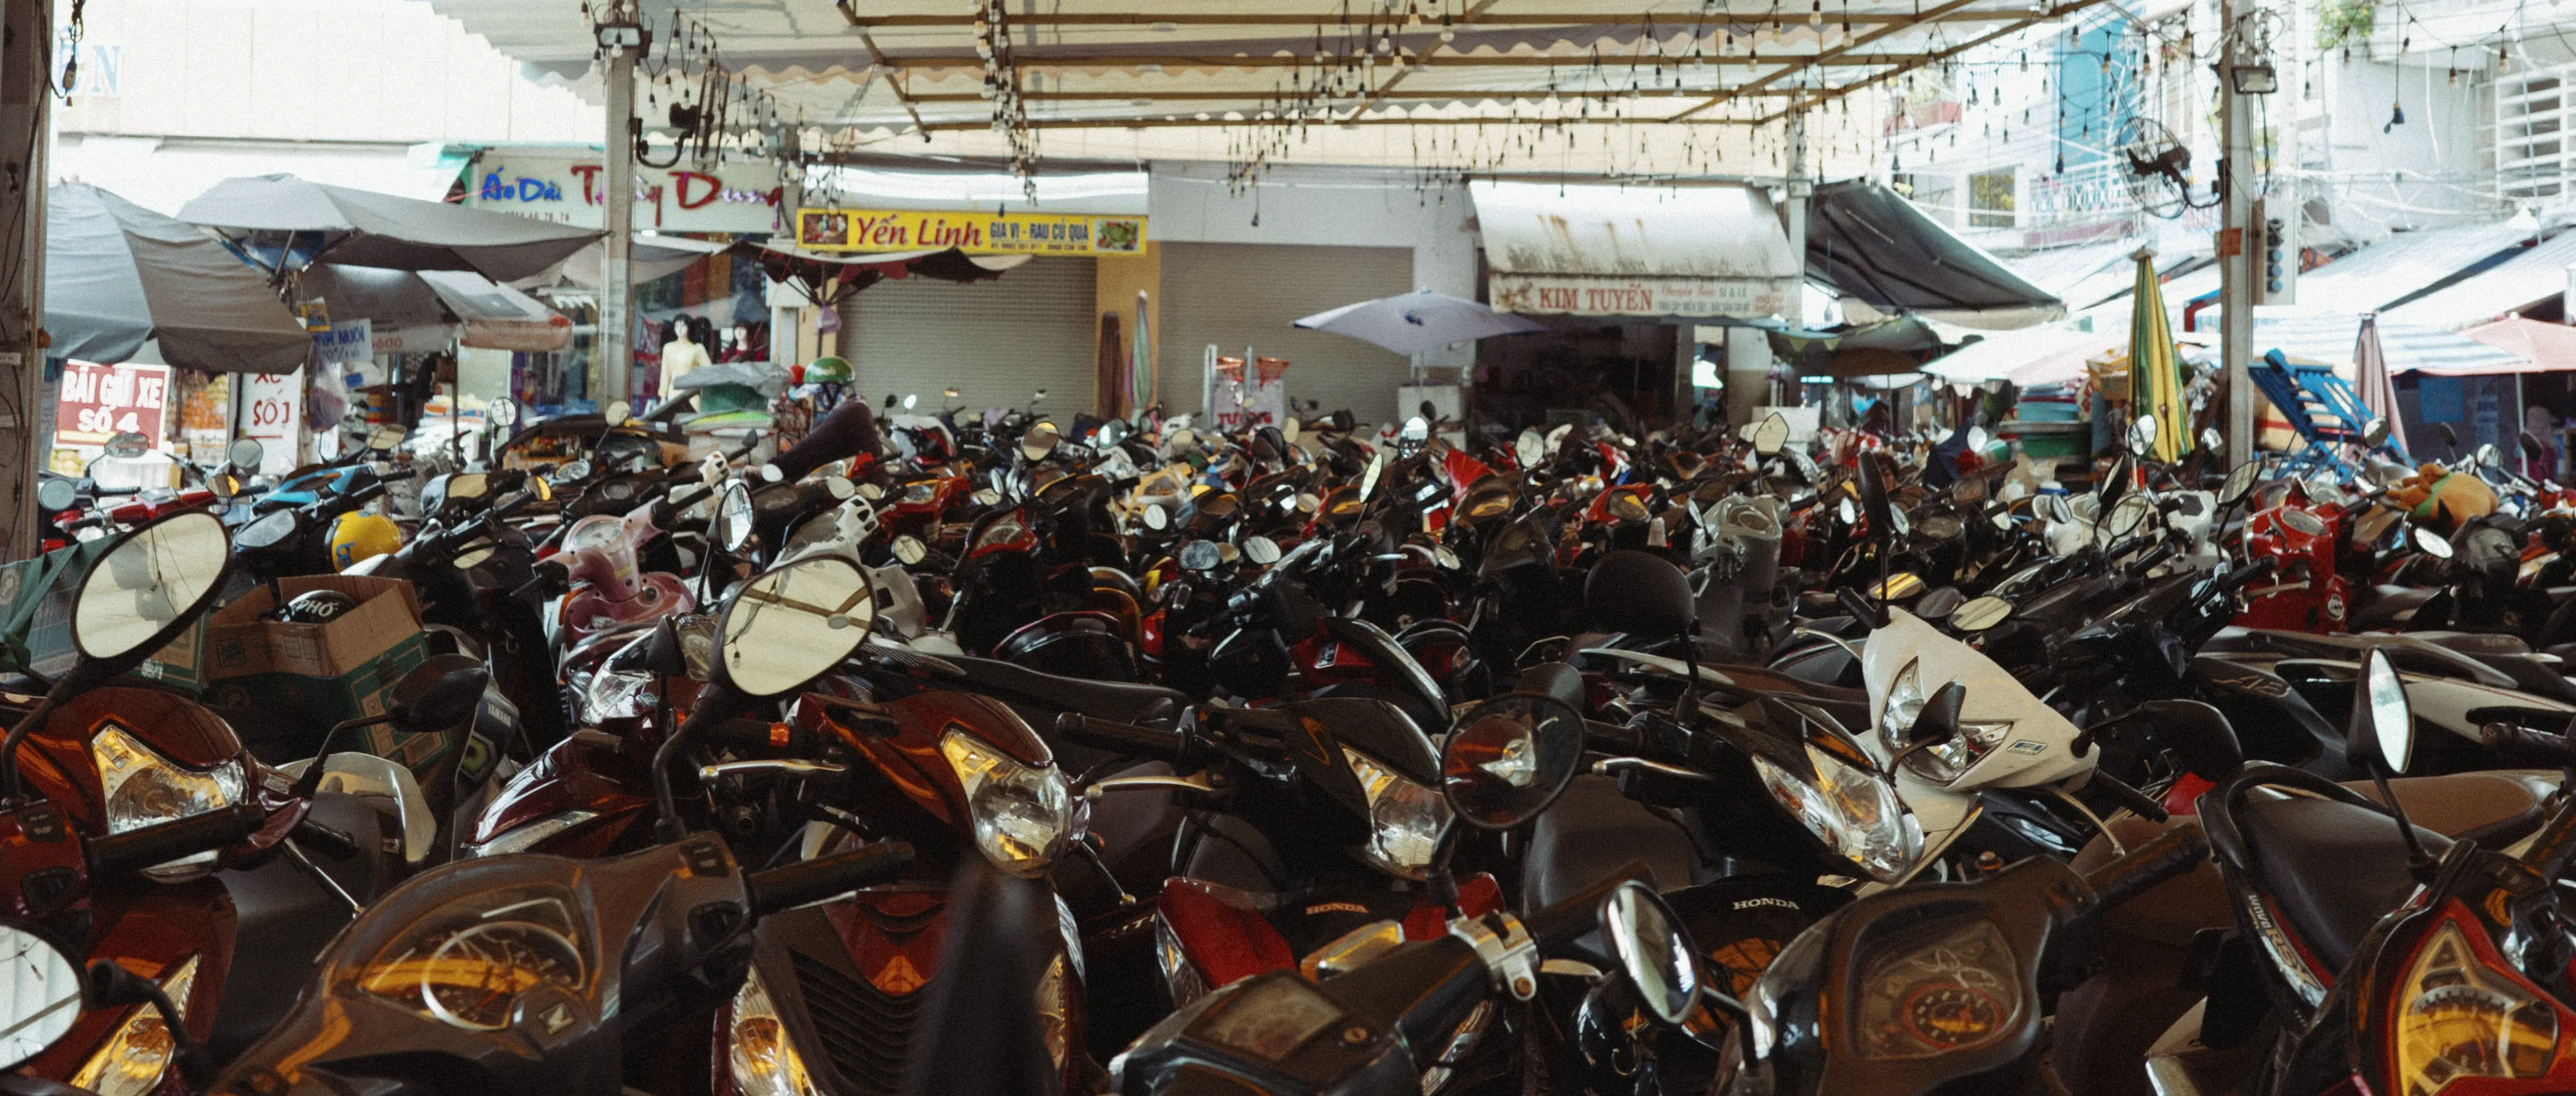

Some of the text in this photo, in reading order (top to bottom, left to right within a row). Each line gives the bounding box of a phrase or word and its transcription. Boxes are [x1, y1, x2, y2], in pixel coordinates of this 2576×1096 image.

[482, 166, 562, 202] Áo Dài
[668, 172, 784, 230] Dung
[857, 214, 982, 248] Yến Linh
[990, 222, 1008, 238] GIA
[1029, 222, 1049, 239] RAU
[1539, 288, 1579, 310] KIM
[1586, 283, 1654, 311] TUYẾN
[135, 377, 163, 409] XE
[116, 411, 140, 434] 4
[488, 703, 511, 728] YAMAHA
[1304, 902, 1370, 915] HONDA
[1733, 897, 1800, 910] HONDA
[2265, 928, 2320, 989] RSX
